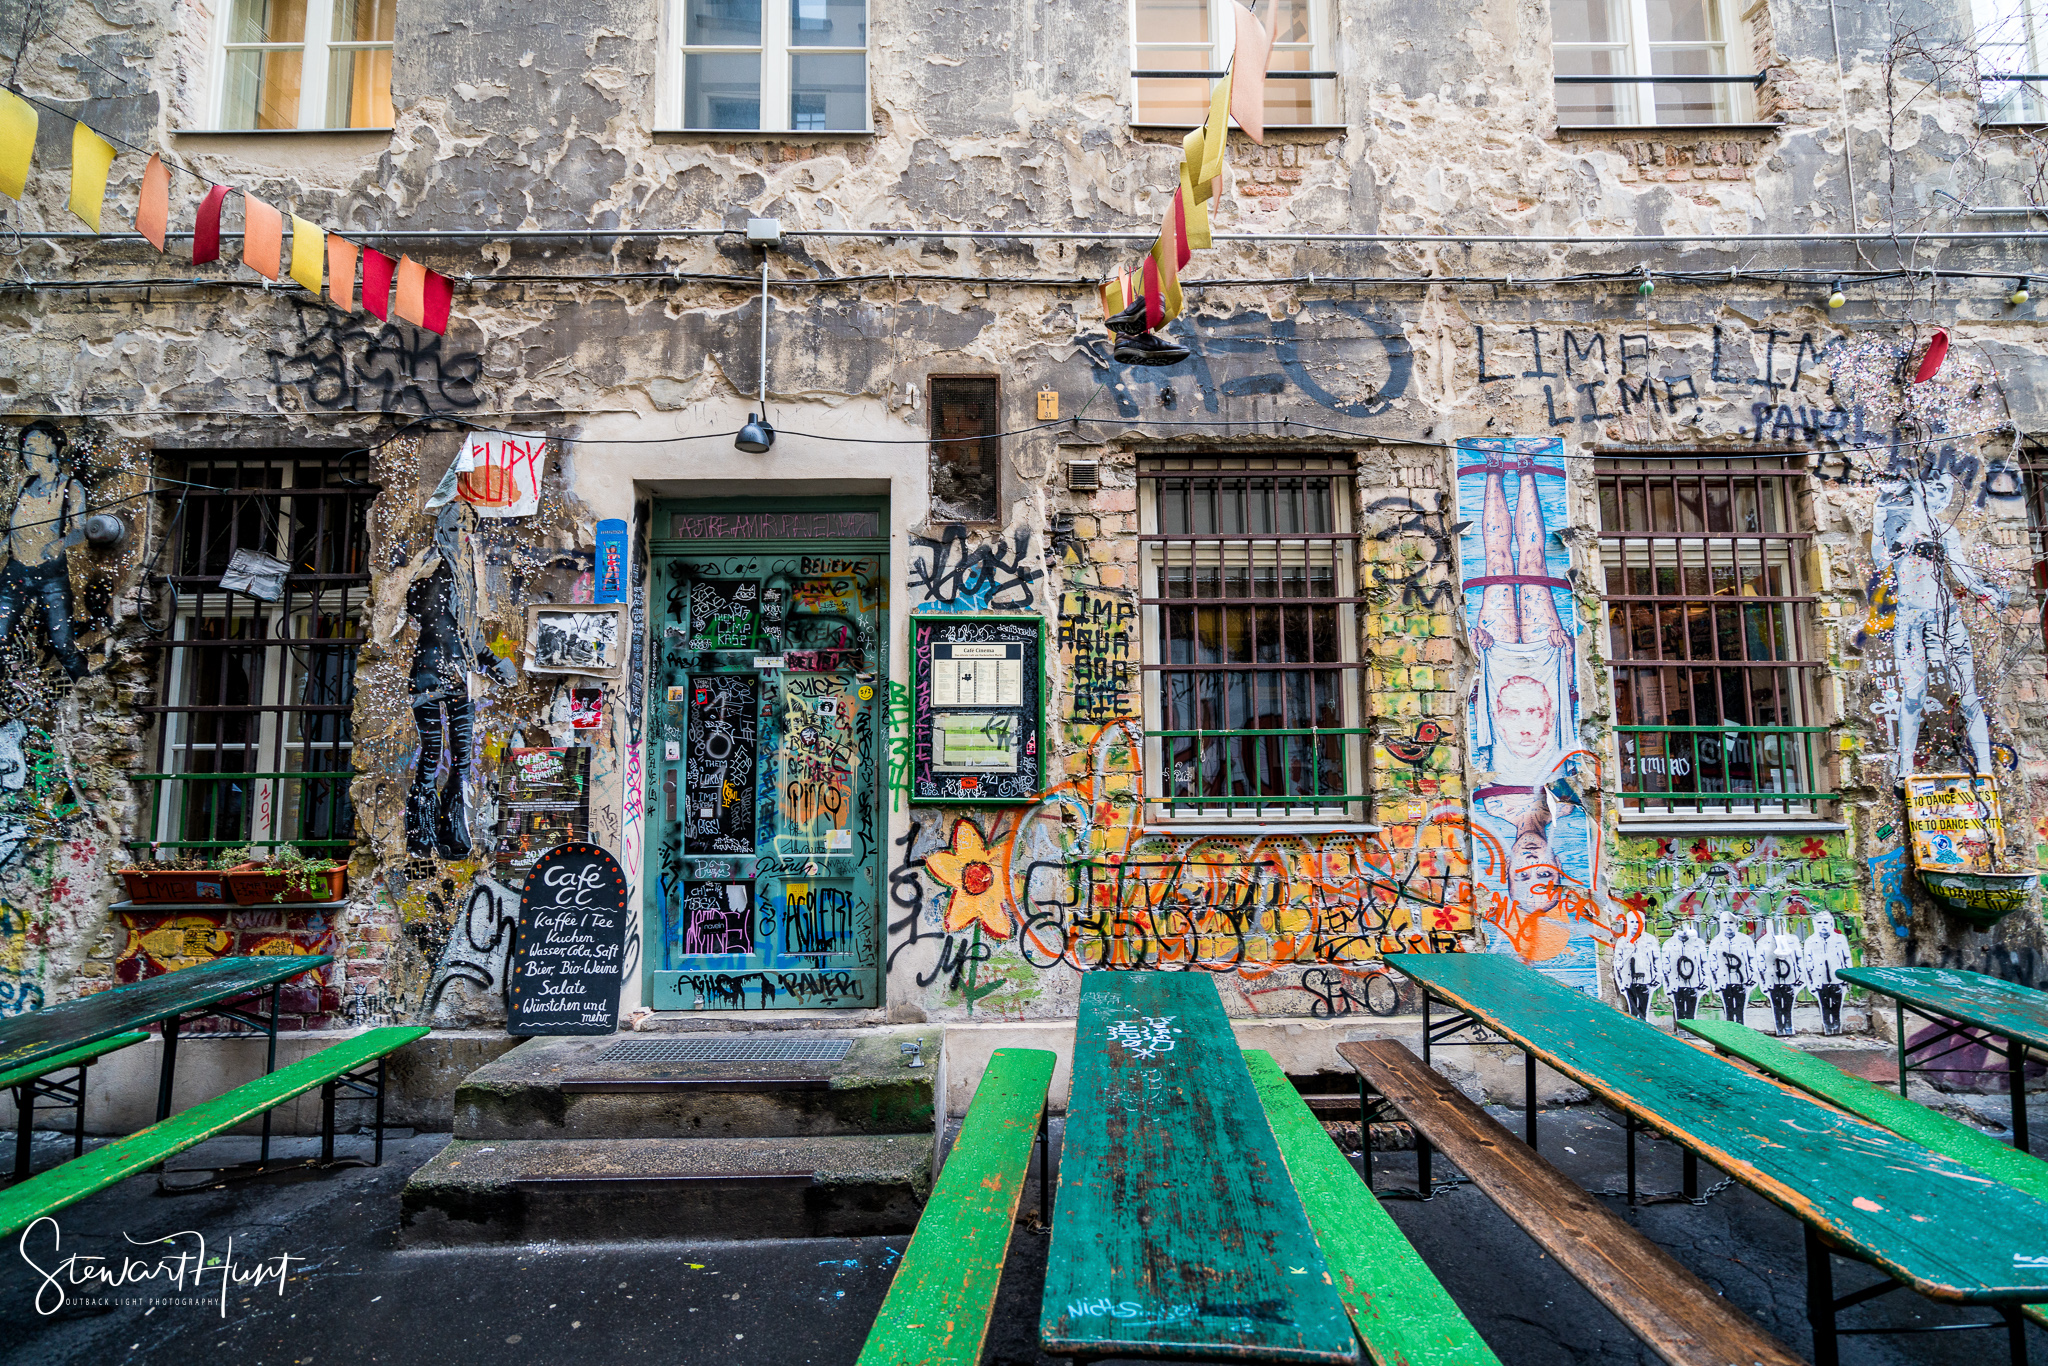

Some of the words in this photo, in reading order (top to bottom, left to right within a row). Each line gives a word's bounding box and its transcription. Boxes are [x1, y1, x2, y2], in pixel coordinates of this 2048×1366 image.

[724, 557, 760, 578] Cafe
[516, 752, 547, 767] COMICS
[1914, 797, 1924, 807] TO
[1927, 793, 1956, 806] DANCE
[1925, 820, 1937, 831] TO
[1940, 819, 1969, 830] DANCE
[544, 863, 606, 890] Café
[1932, 885, 1945, 896] TO
[1949, 888, 1991, 900] DANCE
[534, 912, 578, 931] Kaffee
[580, 914, 588, 927] /
[592, 913, 614, 928] Tee
[546, 929, 594, 943] Kuchen
[529, 944, 566, 957] Wasser,
[566, 944, 592, 957] Cola,
[593, 944, 619, 960] Saft
[525, 960, 555, 977] Bier,
[559, 959, 619, 975] Bio-Weine
[538, 980, 587, 995] Salate
[522, 998, 580, 1013] Würstchen
[583, 998, 607, 1012] und
